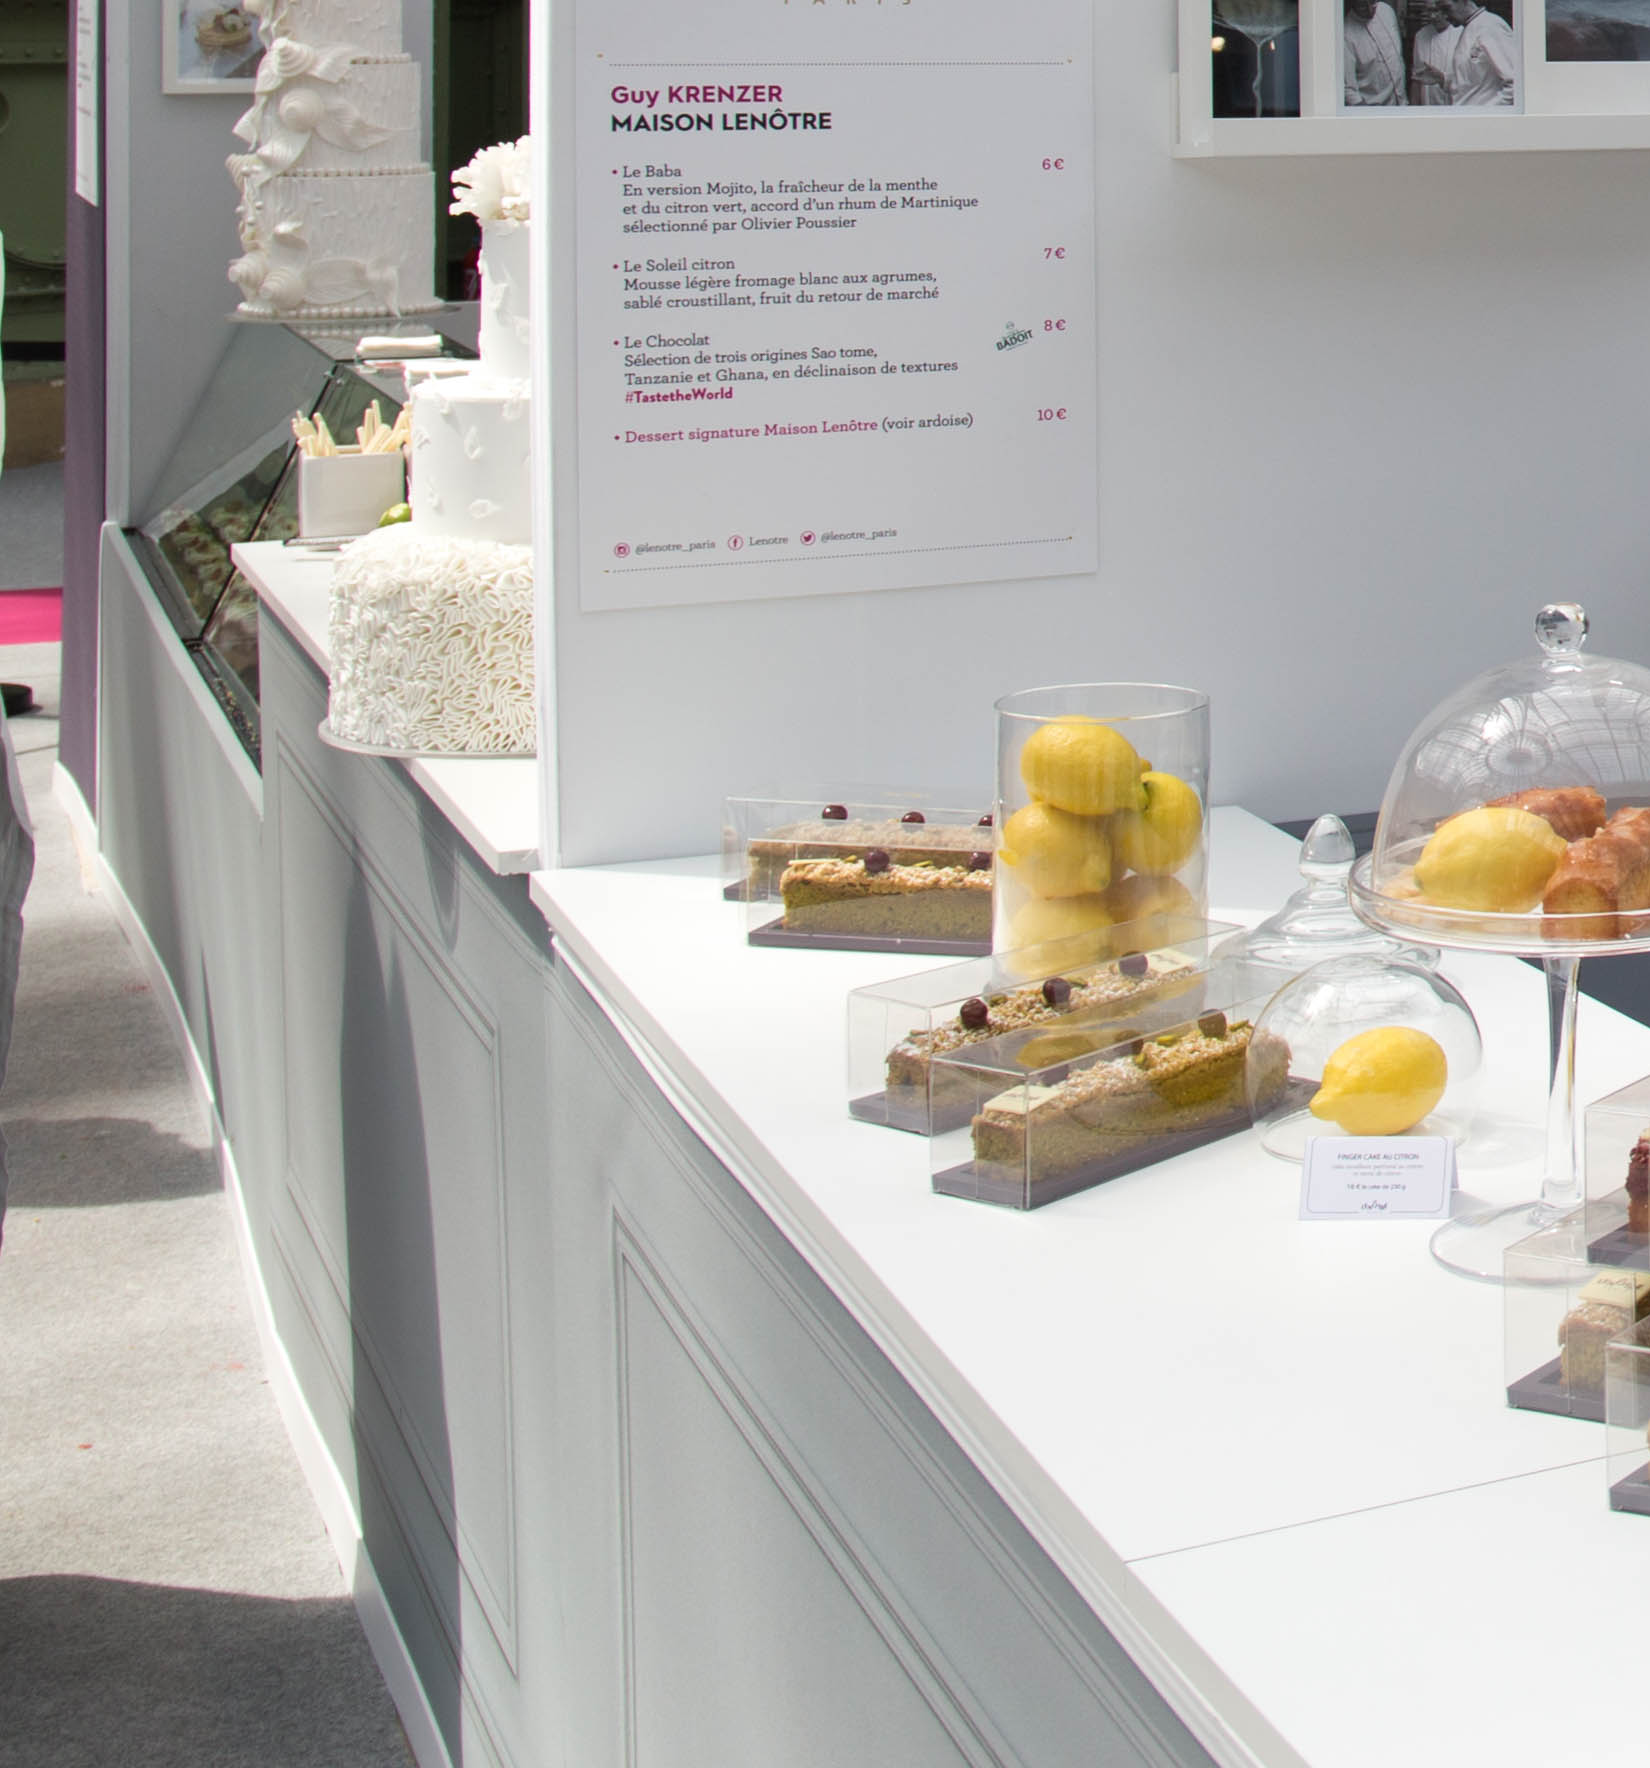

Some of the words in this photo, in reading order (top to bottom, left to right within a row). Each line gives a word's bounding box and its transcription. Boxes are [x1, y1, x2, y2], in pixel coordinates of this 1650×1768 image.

[611, 86, 660, 108] Guy
[668, 85, 783, 104] KRENZER
[612, 113, 713, 132] MAISON
[722, 108, 832, 131] LENÔTRE
[623, 165, 641, 178] Le
[645, 163, 682, 177] Baba
[1042, 158, 1051, 170] 6
[1054, 158, 1064, 170] €
[623, 184, 643, 196] En
[647, 183, 702, 196] version
[707, 182, 757, 197] Mojito,
[761, 180, 774, 194] la
[778, 180, 844, 193] fraîcheur
[848, 178, 865, 192] de
[869, 177, 882, 192] la
[886, 177, 938, 191] menthe
[623, 204, 637, 215] et
[641, 201, 661, 215] du
[664, 202, 709, 214] citron
[712, 202, 747, 214] vert,
[751, 198, 799, 212] accord
[838, 196, 876, 210] rhum
[880, 195, 898, 209] de
[901, 196, 979, 211] Martinique
[623, 219, 708, 234] sélectionné
[712, 221, 737, 234] par
[741, 216, 793, 230] Olivier
[796, 215, 857, 229] Poussier
[1044, 247, 1053, 259] 7
[1054, 247, 1065, 259] €
[623, 259, 642, 272] Le
[646, 257, 688, 272] Soleil
[692, 258, 735, 271] citron
[624, 278, 681, 291] Mousse
[685, 275, 731, 292] légère
[735, 274, 795, 289] fromage
[799, 272, 839, 285] blanc
[842, 274, 868, 284] aux
[871, 273, 937, 288] agrumes,
[624, 295, 663, 309] sablé
[666, 292, 756, 308] croustillant,
[760, 291, 792, 305] fruit
[796, 290, 814, 304] du
[818, 292, 863, 303] retour
[866, 287, 883, 301] de
[887, 286, 939, 300] marché
[1044, 319, 1053, 331] 8
[1055, 319, 1066, 331] €
[624, 335, 642, 349] Le
[646, 332, 710, 348] Chocolat
[996, 330, 1033, 351] BADOIT
[624, 353, 691, 367] Sélection
[694, 350, 712, 364] de
[715, 350, 747, 363] trois
[750, 348, 808, 364] origines
[811, 347, 837, 359] Sao
[840, 348, 877, 359] tome,
[624, 371, 693, 385] Tanzanie
[697, 372, 712, 383] et
[716, 367, 768, 382] Ghana,
[772, 364, 790, 379] en
[794, 363, 877, 378] déclinaison
[880, 360, 897, 374] de
[901, 362, 959, 373] textures
[625, 386, 733, 404] #TastetheWorld
[1038, 408, 1054, 421] 10
[1056, 408, 1067, 420] €
[625, 430, 684, 444] Dessert
[688, 427, 760, 443] signature
[764, 423, 818, 436] Maison
[822, 420, 878, 433] Lenôtre
[882, 416, 915, 433] (voir
[918, 412, 973, 428] ardoise)
[749, 536, 788, 546] Lenotre
[1363, 1153, 1381, 1161] CAKE
[1393, 1153, 1419, 1161] CITRON
